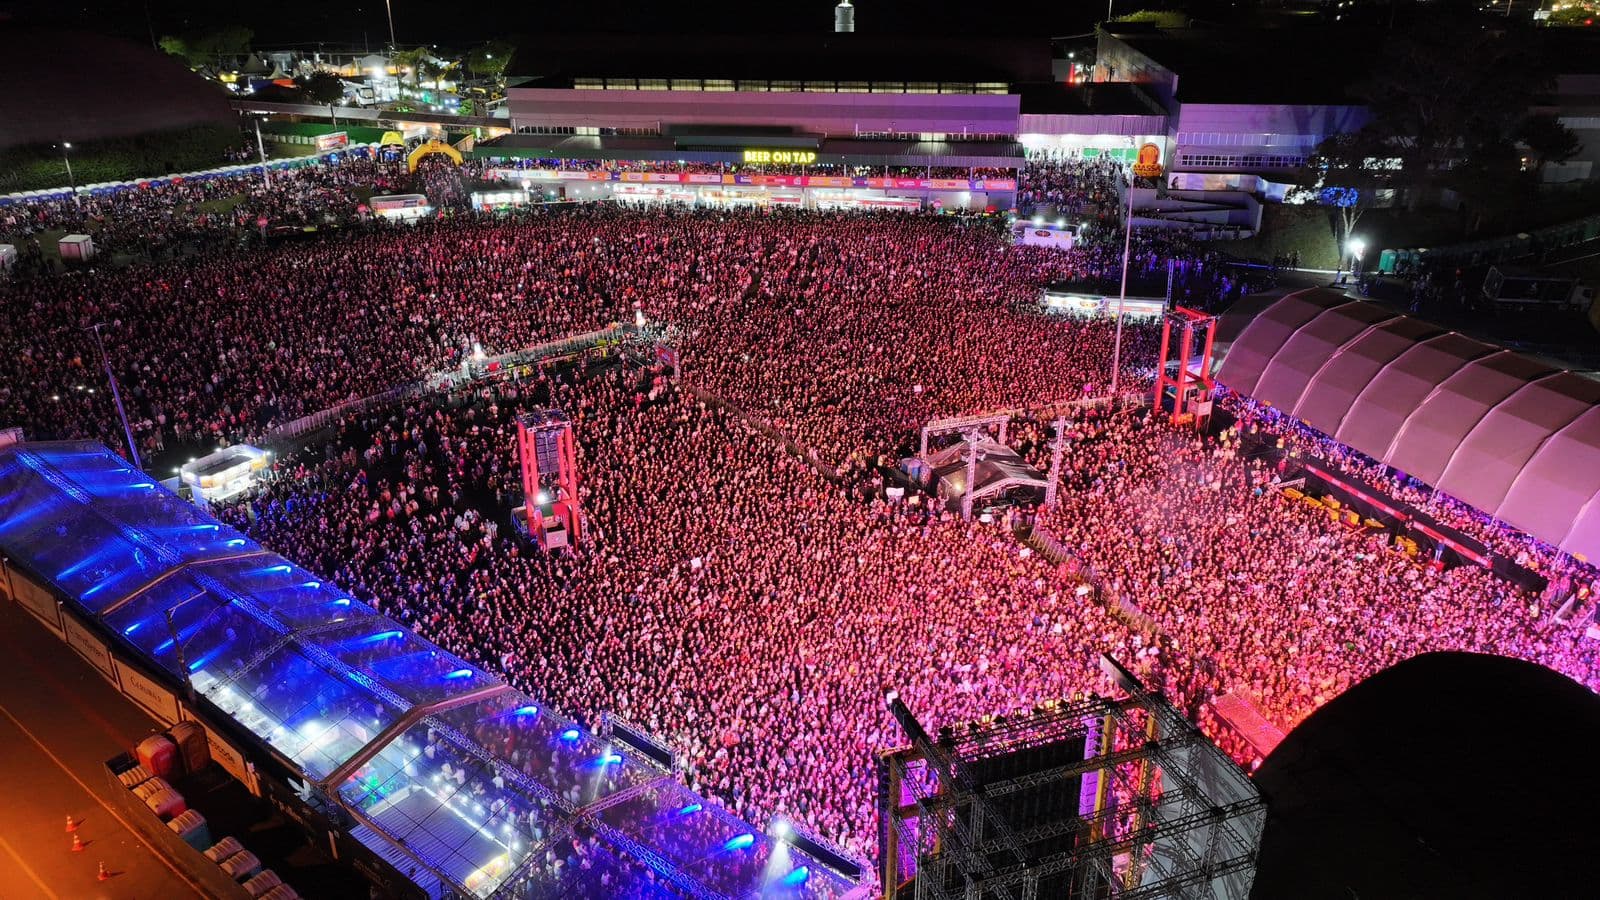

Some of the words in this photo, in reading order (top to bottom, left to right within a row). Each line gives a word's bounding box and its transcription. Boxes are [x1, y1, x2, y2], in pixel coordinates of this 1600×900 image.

[744, 150, 770, 162] BEER
[773, 151, 791, 163] ON
[792, 151, 815, 163] TAP
